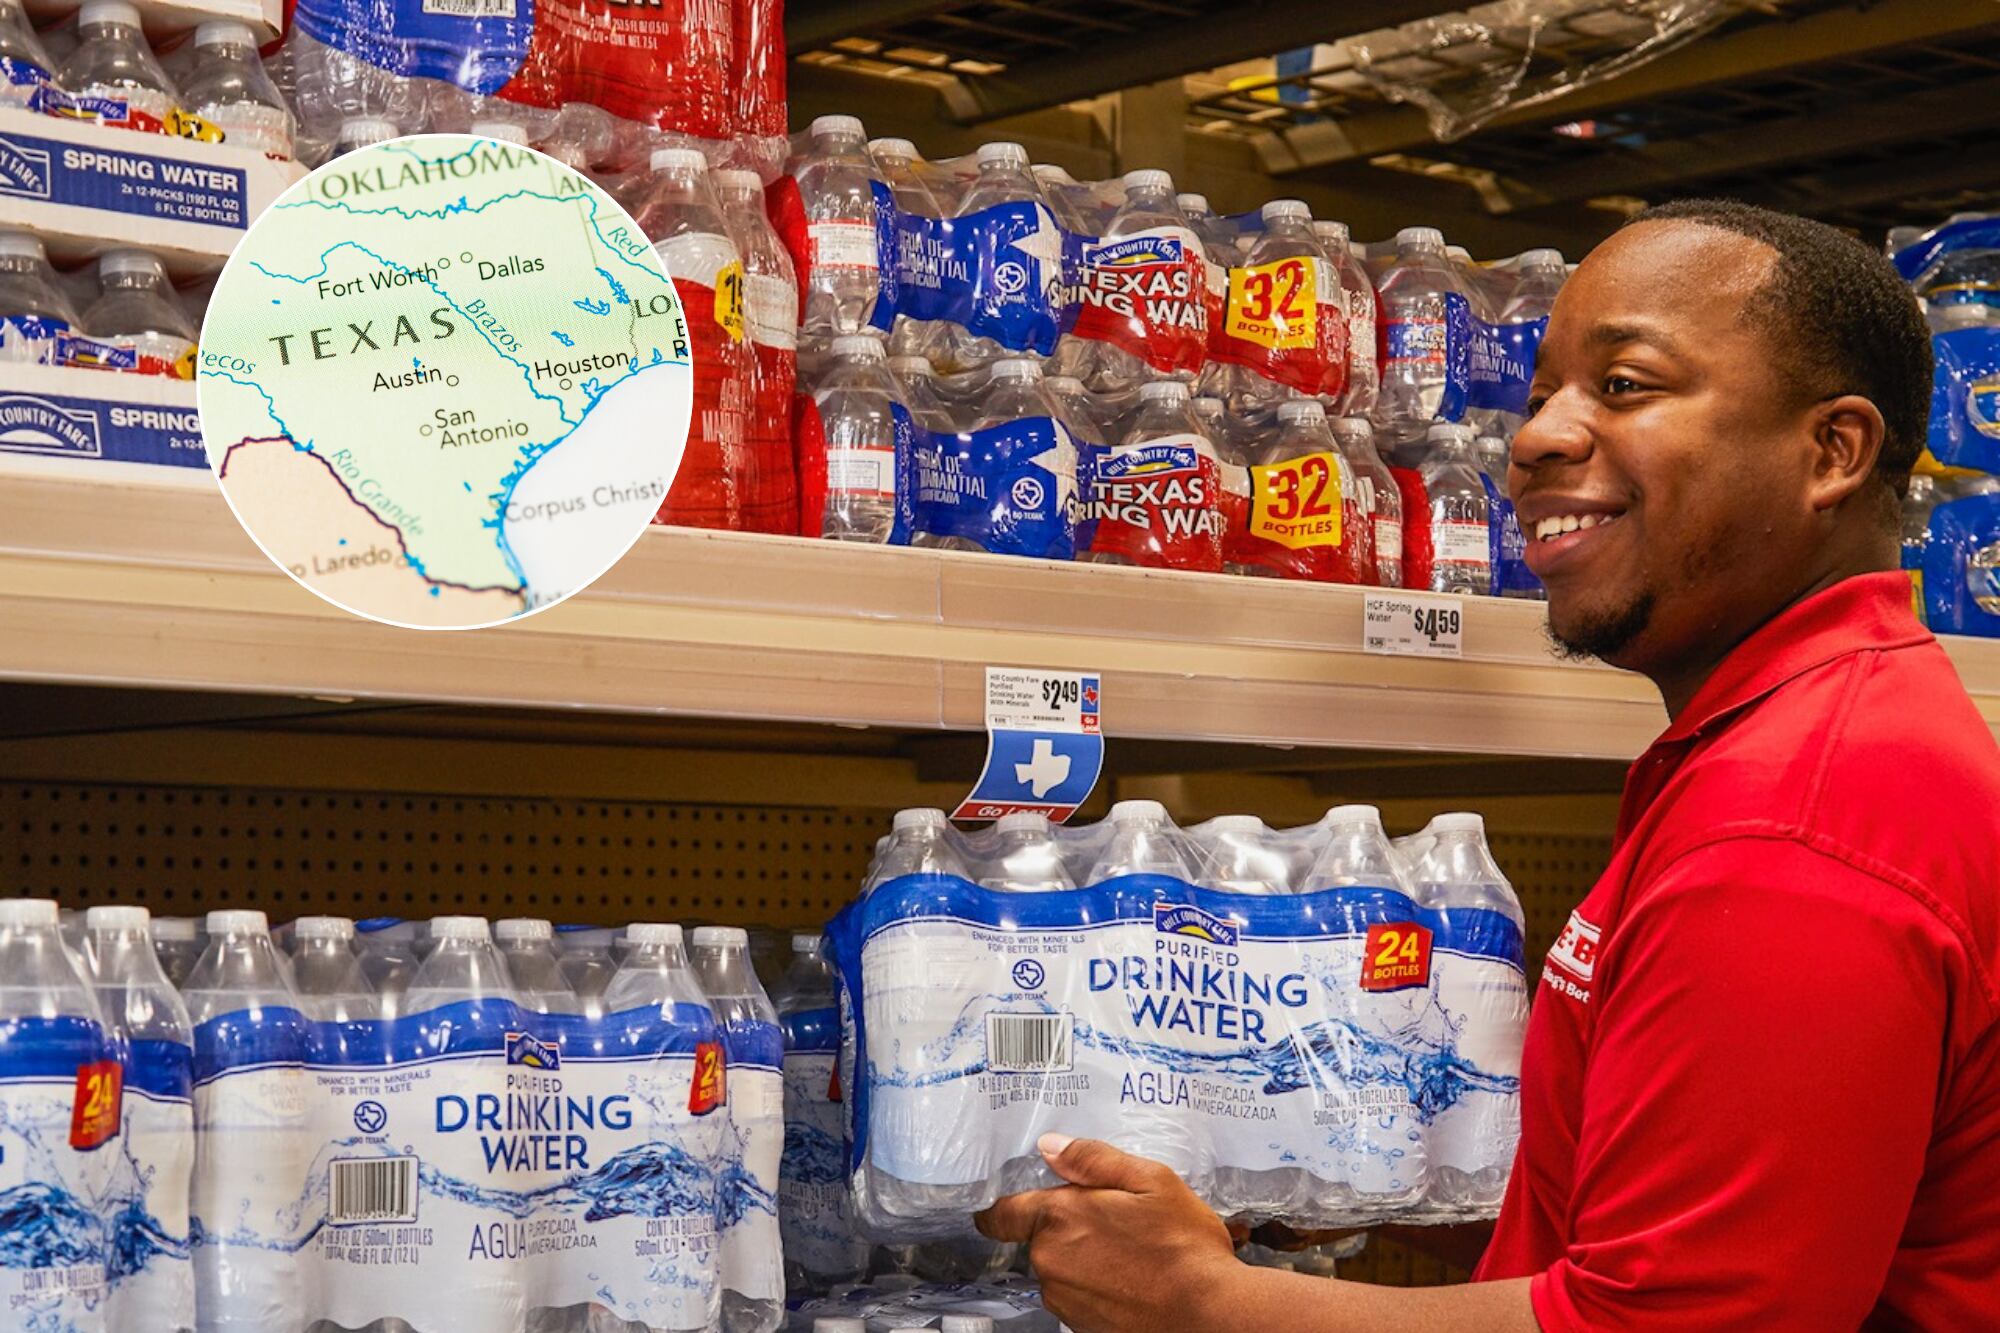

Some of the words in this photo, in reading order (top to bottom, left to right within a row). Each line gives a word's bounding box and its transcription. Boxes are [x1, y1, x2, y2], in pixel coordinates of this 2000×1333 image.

[9, 155, 39, 189] FARE
[63, 148, 154, 180] SPRING
[160, 163, 239, 193] WATER
[121, 184, 132, 194] 2x
[135, 185, 184, 203] 12-PACKS
[208, 196, 220, 208] FL
[222, 198, 240, 211] OZ)
[163, 203, 176, 214] FL
[178, 205, 193, 217] OZ
[194, 207, 240, 224] BOTTLES
[1077, 265, 1189, 298] TEXAS
[1241, 260, 1306, 321] 32
[1236, 320, 1305, 339] BOTTES
[110, 407, 202, 432] SPRING
[57, 419, 90, 450] FARE
[1126, 448, 1168, 466] COUNTRY
[1090, 477, 1204, 506] TEXAS
[1266, 456, 1331, 520] 32
[1066, 497, 1151, 530] SRING
[1262, 519, 1333, 537] BOTTLES
[1366, 601, 1384, 610] HCF
[1386, 601, 1412, 615] Spring
[1367, 612, 1392, 623] Water
[1001, 675, 1025, 684] Country
[990, 691, 1015, 700] Drinking
[1016, 691, 1035, 700] Water
[977, 806, 1003, 817] Go
[971, 931, 1015, 944] ENHANCED
[1017, 936, 1040, 944] WITH
[988, 943, 1004, 952] FOR
[1007, 945, 1039, 953] BETTER
[1042, 945, 1069, 953] TASTE
[1374, 930, 1420, 967] 24
[1155, 939, 1240, 967] PURIFIED
[1089, 955, 1308, 1008] DRINKING
[1373, 965, 1420, 980] BOTTLES
[1126, 994, 1267, 1043] WATER
[359, 1076, 380, 1085] WITH
[384, 1070, 431, 1084] MINERALS
[385, 1082, 412, 1093] TASTE
[1119, 1071, 1190, 1108] AGUA
[1192, 1078, 1256, 1103] PURIFICADA
[84, 1073, 113, 1118] 24
[436, 1093, 633, 1133] DRINKING
[1192, 1098, 1278, 1121] MINERALIZADA
[480, 1134, 590, 1175] WATER
[396, 1227, 434, 1246] BOTTLES
[469, 1223, 528, 1260] AGUA
